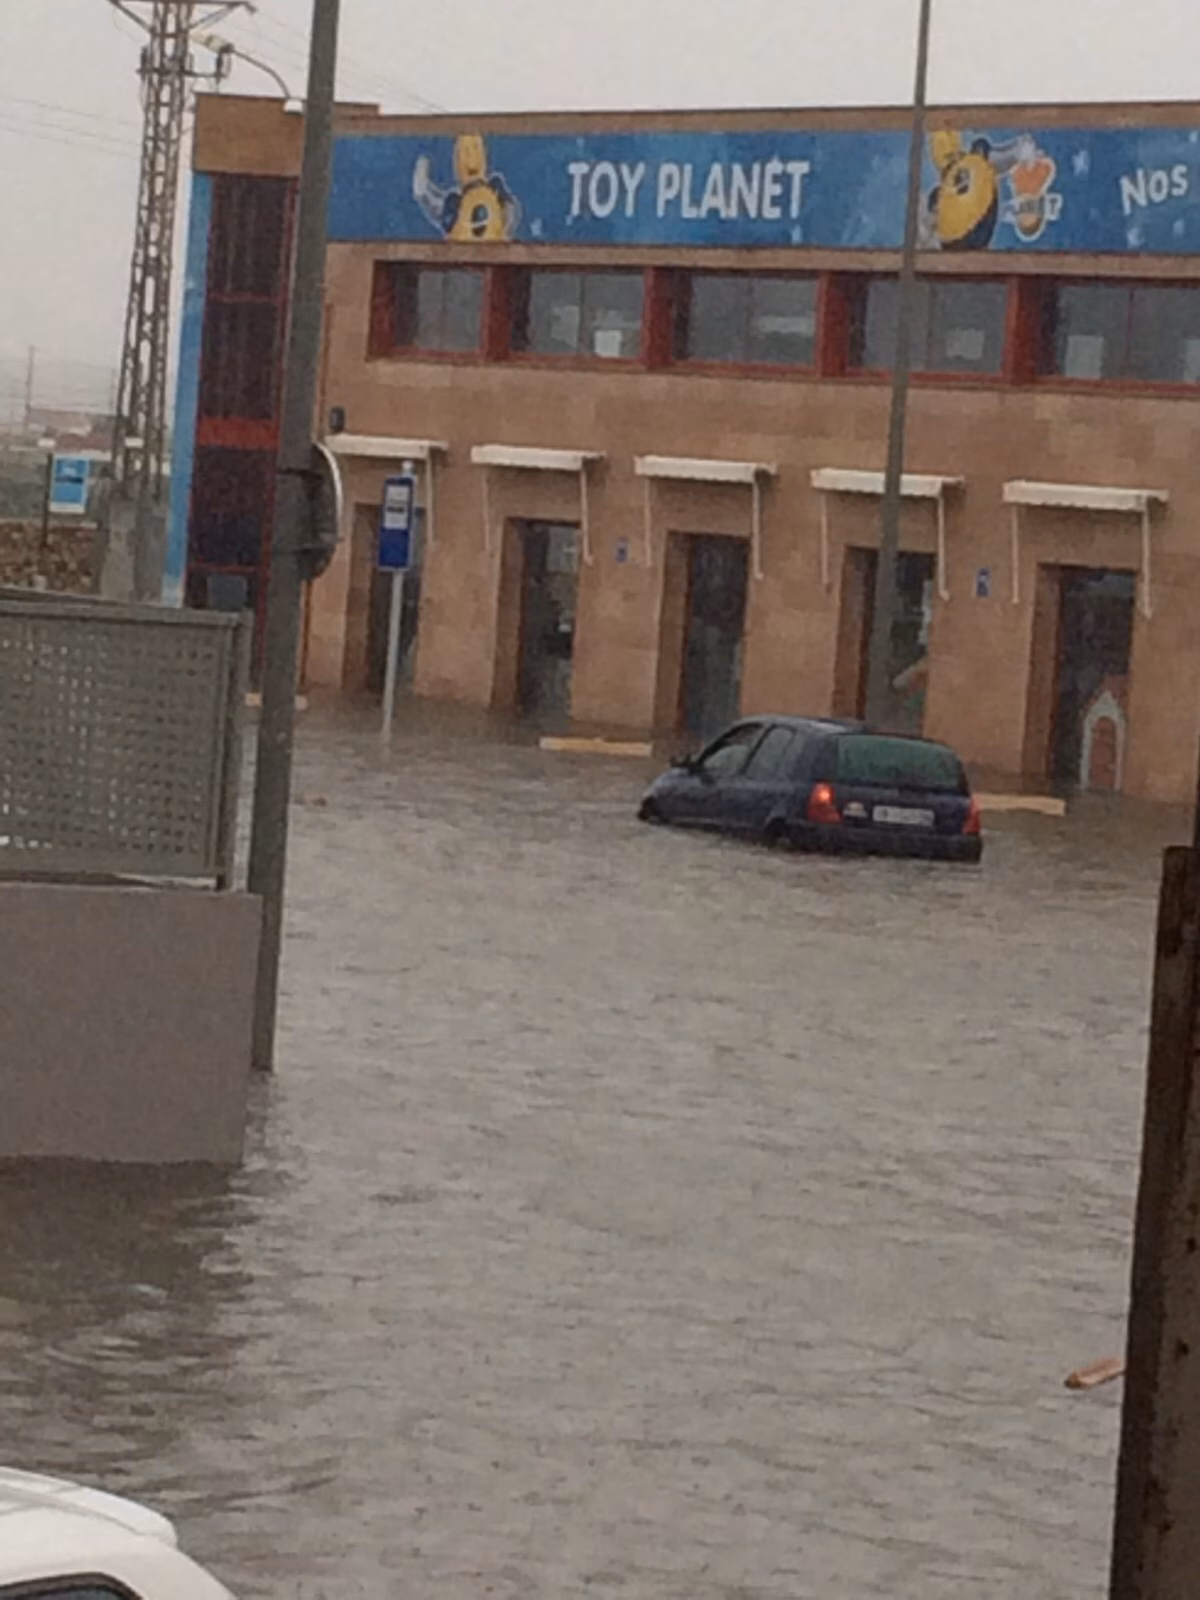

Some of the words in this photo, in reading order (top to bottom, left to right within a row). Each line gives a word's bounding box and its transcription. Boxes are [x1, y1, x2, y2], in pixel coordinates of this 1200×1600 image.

[567, 160, 646, 219] TOY
[655, 158, 811, 219] PLANET
[1119, 164, 1188, 215] NOS
